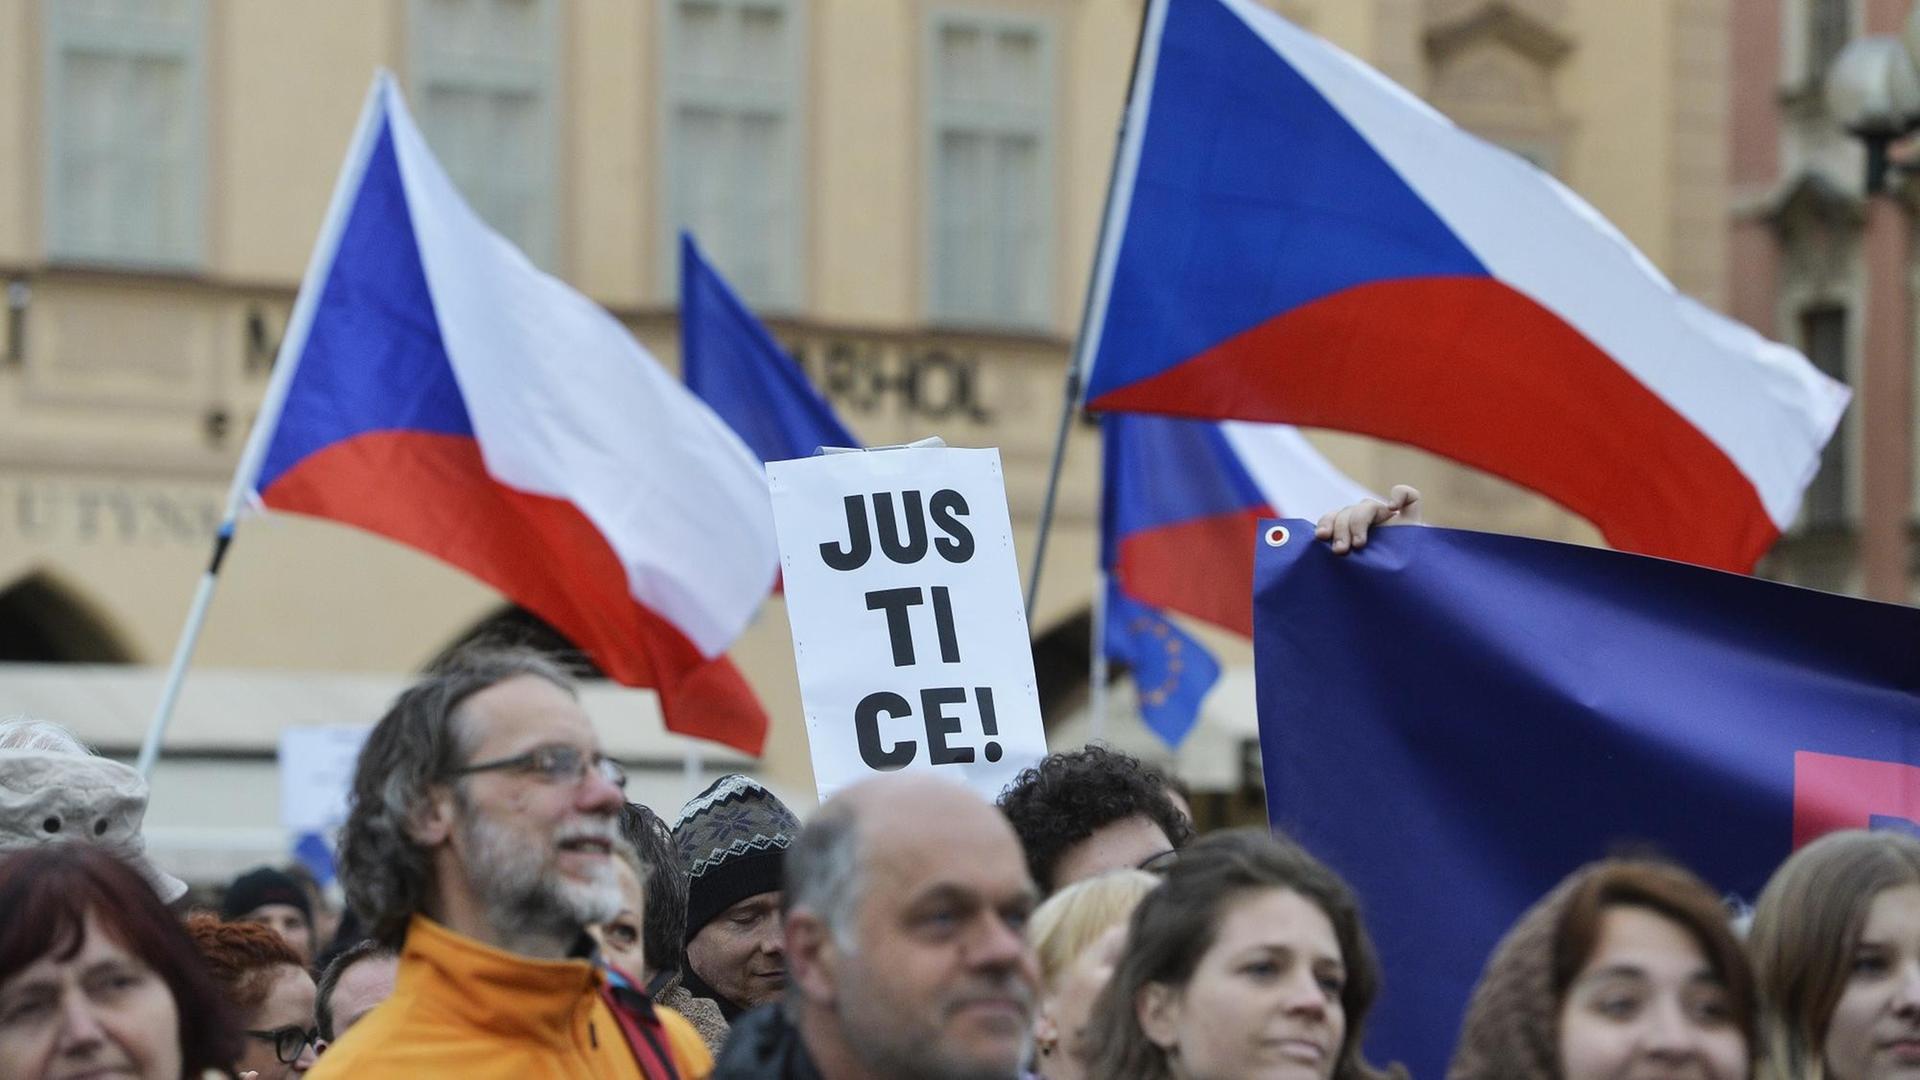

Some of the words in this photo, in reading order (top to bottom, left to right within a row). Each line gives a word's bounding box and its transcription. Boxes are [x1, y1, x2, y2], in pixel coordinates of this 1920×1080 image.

[819, 489, 975, 571] JUS
[865, 586, 961, 667] TI
[854, 687, 1003, 771] CE!
